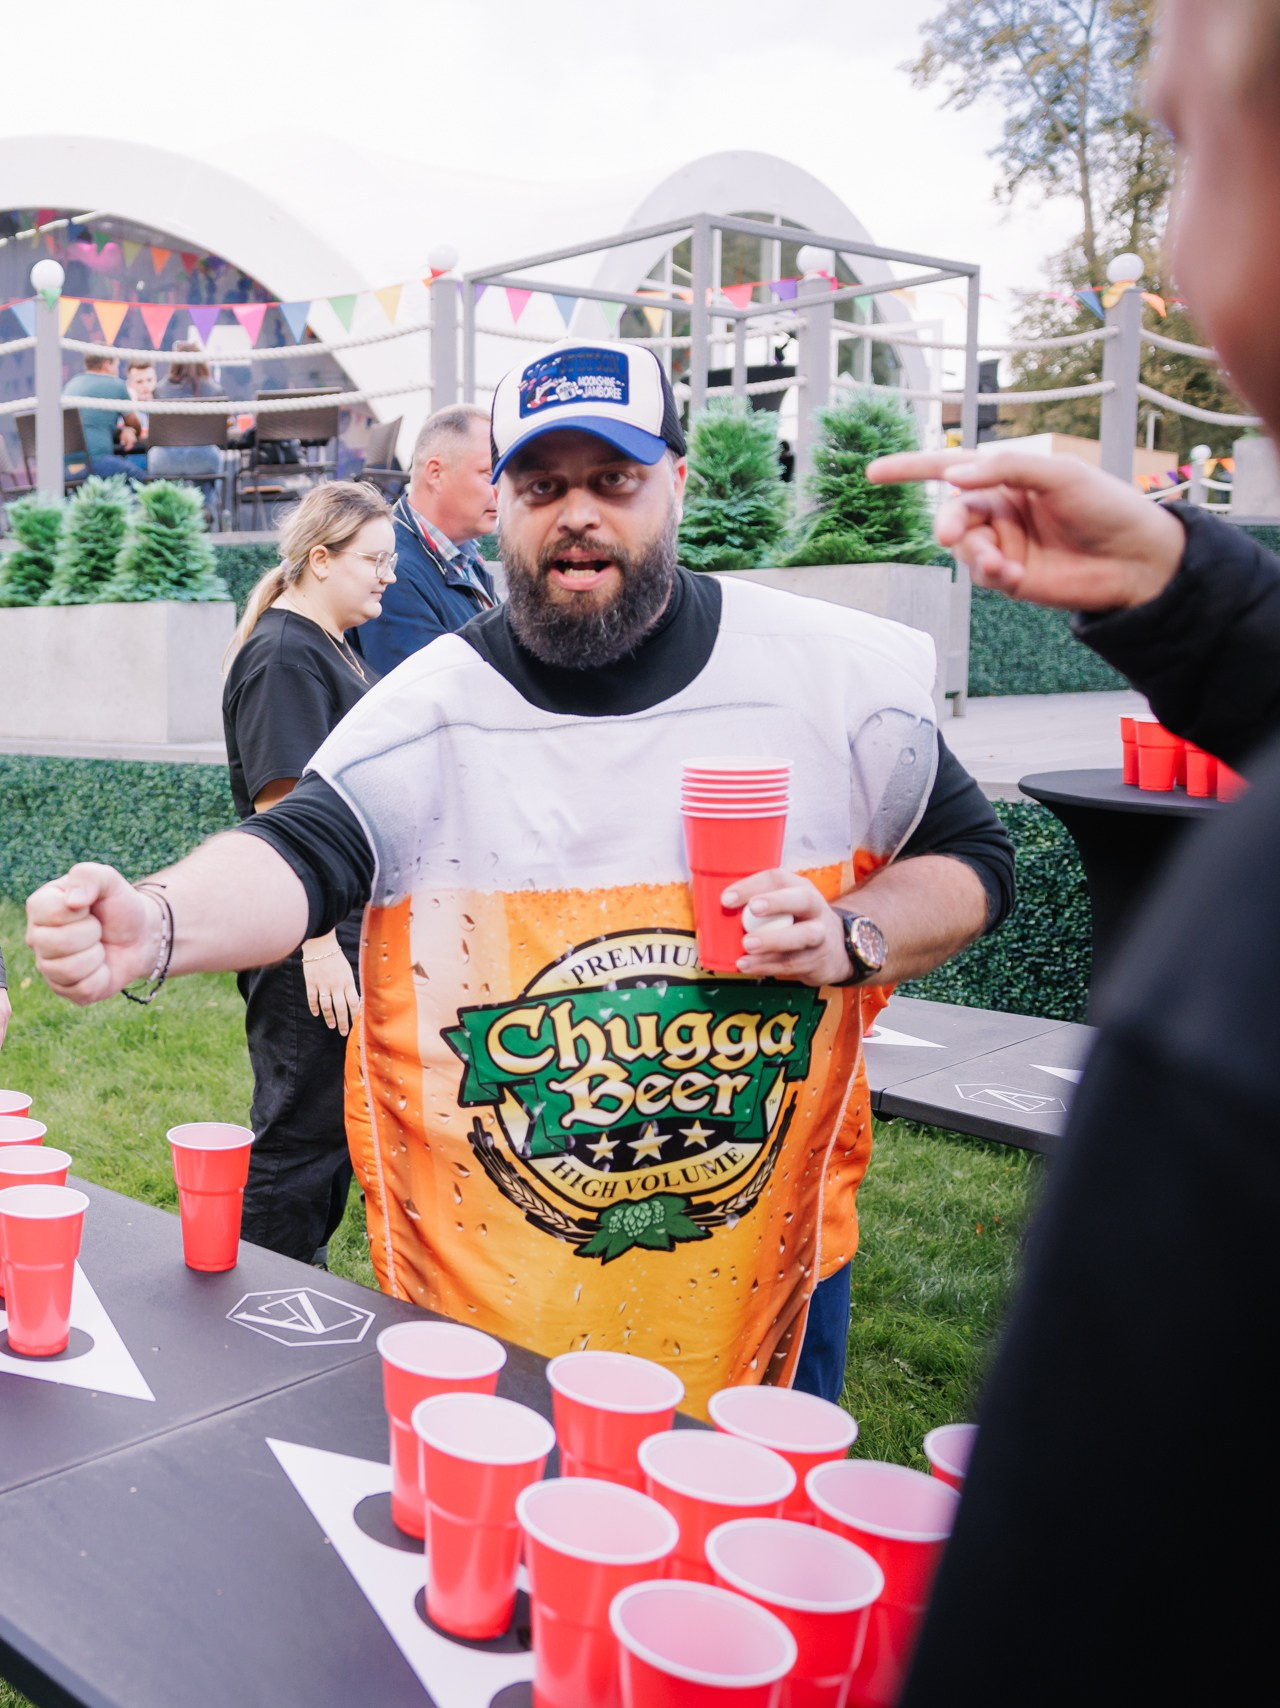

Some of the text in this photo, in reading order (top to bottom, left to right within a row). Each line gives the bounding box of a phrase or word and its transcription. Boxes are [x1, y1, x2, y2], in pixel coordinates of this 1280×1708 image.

[582, 385, 622, 400] JAMBOREE
[570, 943, 715, 985] PREMIU
[485, 999, 801, 1075] Chugga
[547, 1064, 752, 1128] Beer
[550, 1147, 746, 1199] HIGH VOLUME
